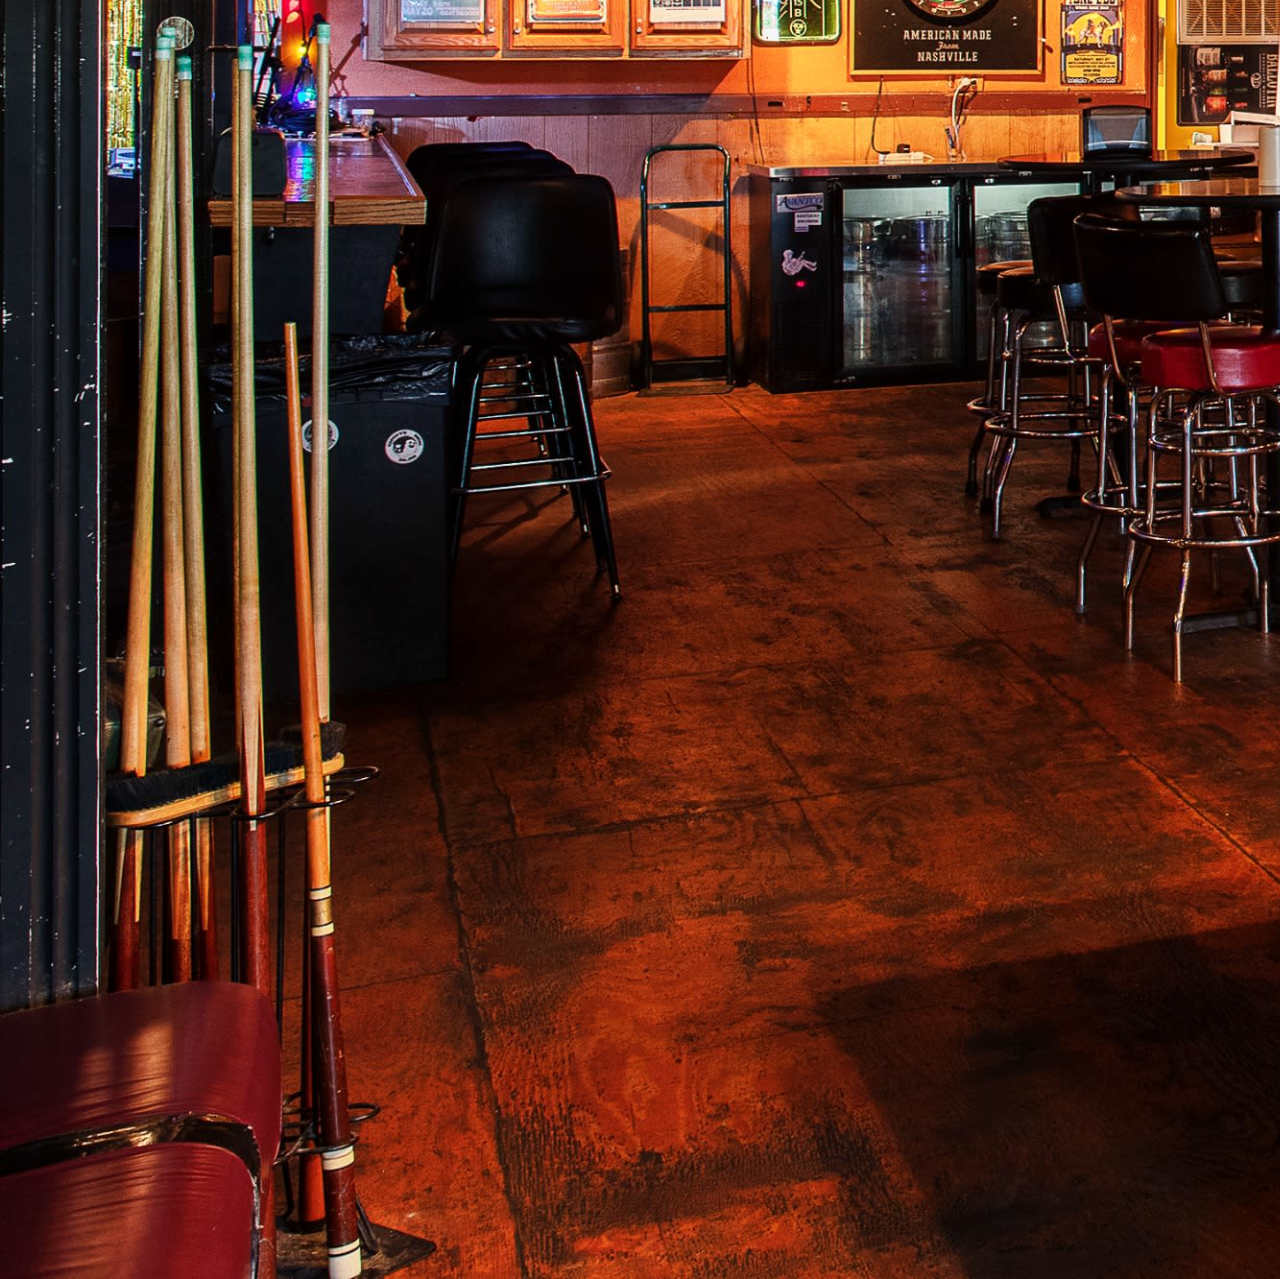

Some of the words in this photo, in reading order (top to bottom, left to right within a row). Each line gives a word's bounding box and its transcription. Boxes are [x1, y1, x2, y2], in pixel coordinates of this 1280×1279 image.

[903, 30, 960, 40] AMERICAN
[962, 30, 992, 40] MADE
[936, 41, 959, 51] From
[917, 51, 978, 62] NASHVILLE
